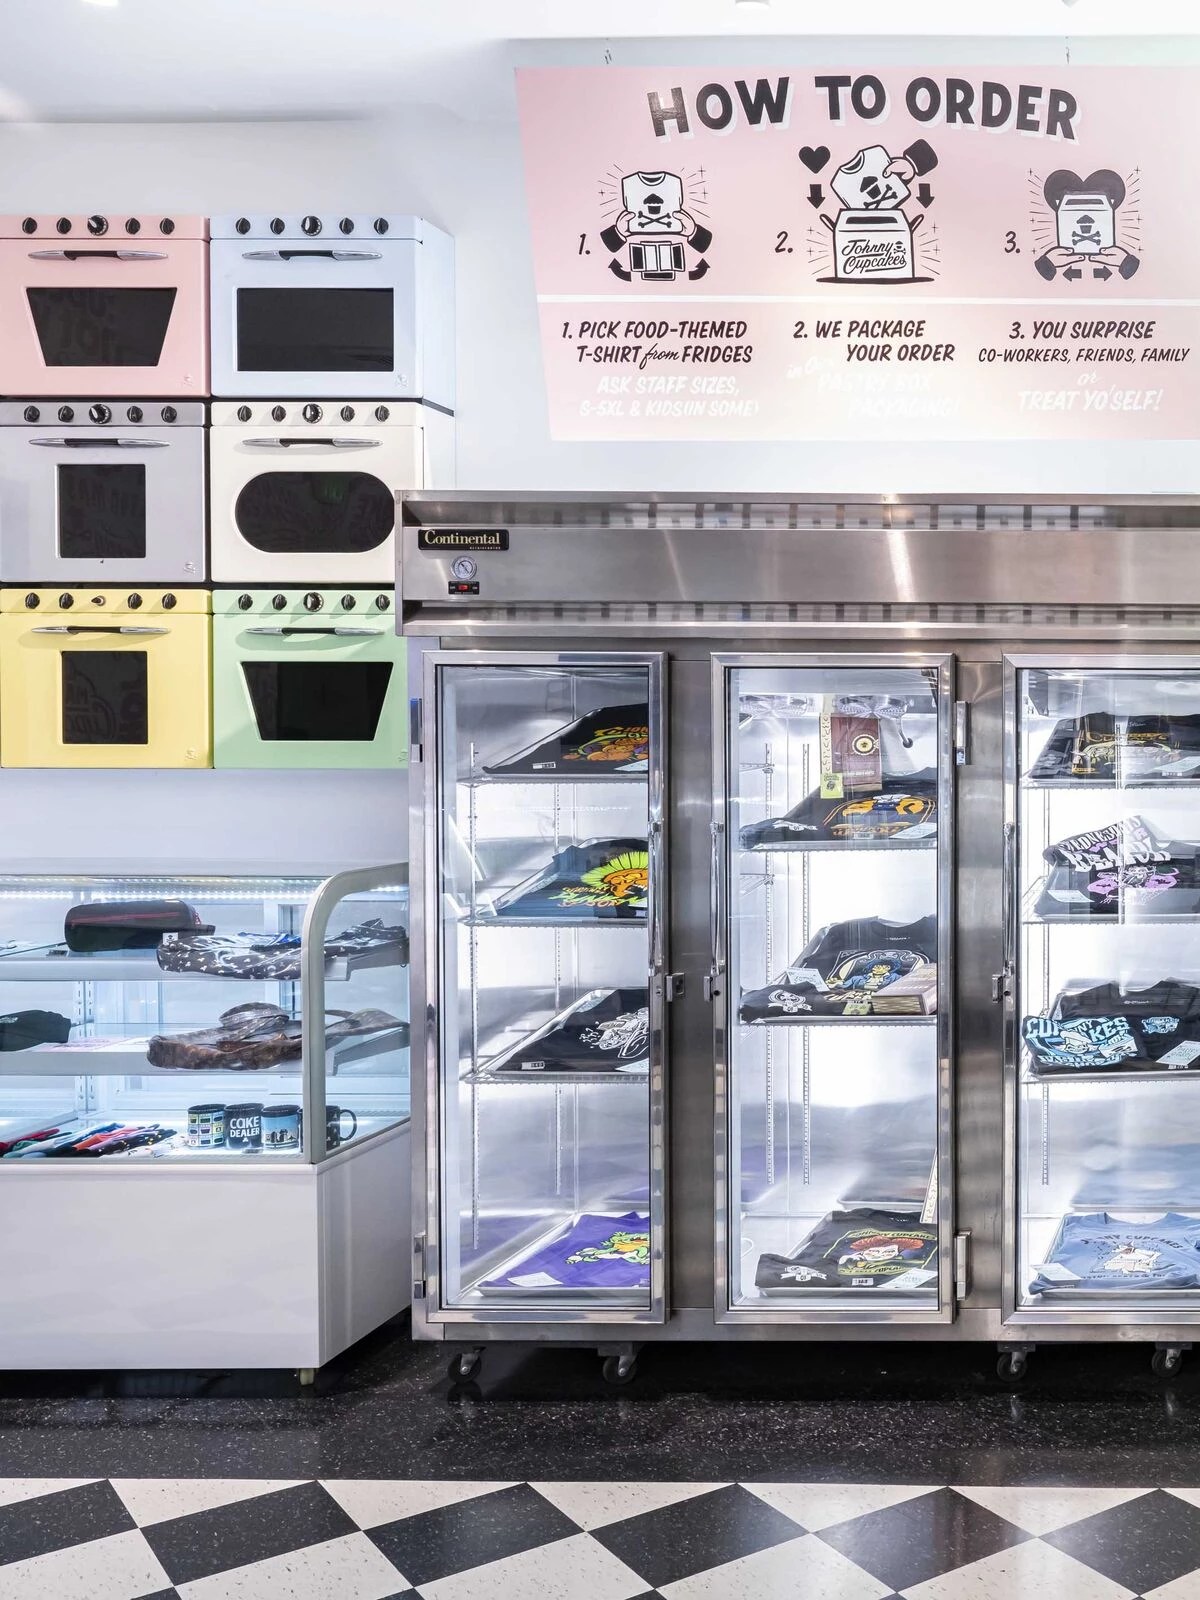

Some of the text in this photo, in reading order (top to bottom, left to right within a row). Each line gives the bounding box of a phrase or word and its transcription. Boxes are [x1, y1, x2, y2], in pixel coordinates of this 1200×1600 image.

[648, 73, 1079, 141] HOW TO ORDER
[577, 232, 592, 256] 1.
[774, 230, 794, 254] 2.
[841, 238, 894, 257] Johnny
[1003, 230, 1022, 254] 3.
[842, 254, 907, 274] Cupcakes
[562, 319, 748, 339] 1. PICK FOOD-THEMED
[793, 319, 926, 339] 2. WE PACKAGE
[1008, 320, 1157, 339] 3. YOU SURPRISE
[576, 342, 753, 370] T-SHIRT from FRIDGES
[846, 343, 956, 362] YOUR ORDER
[978, 347, 1190, 364] CO-WORKERS, FRIENDS, FAMILY
[596, 376, 633, 394] ASK
[634, 376, 690, 394] STAFF
[1017, 389, 1081, 412] TREAT
[424, 529, 501, 545] Continental
[230, 1127, 260, 1138] DEALER
